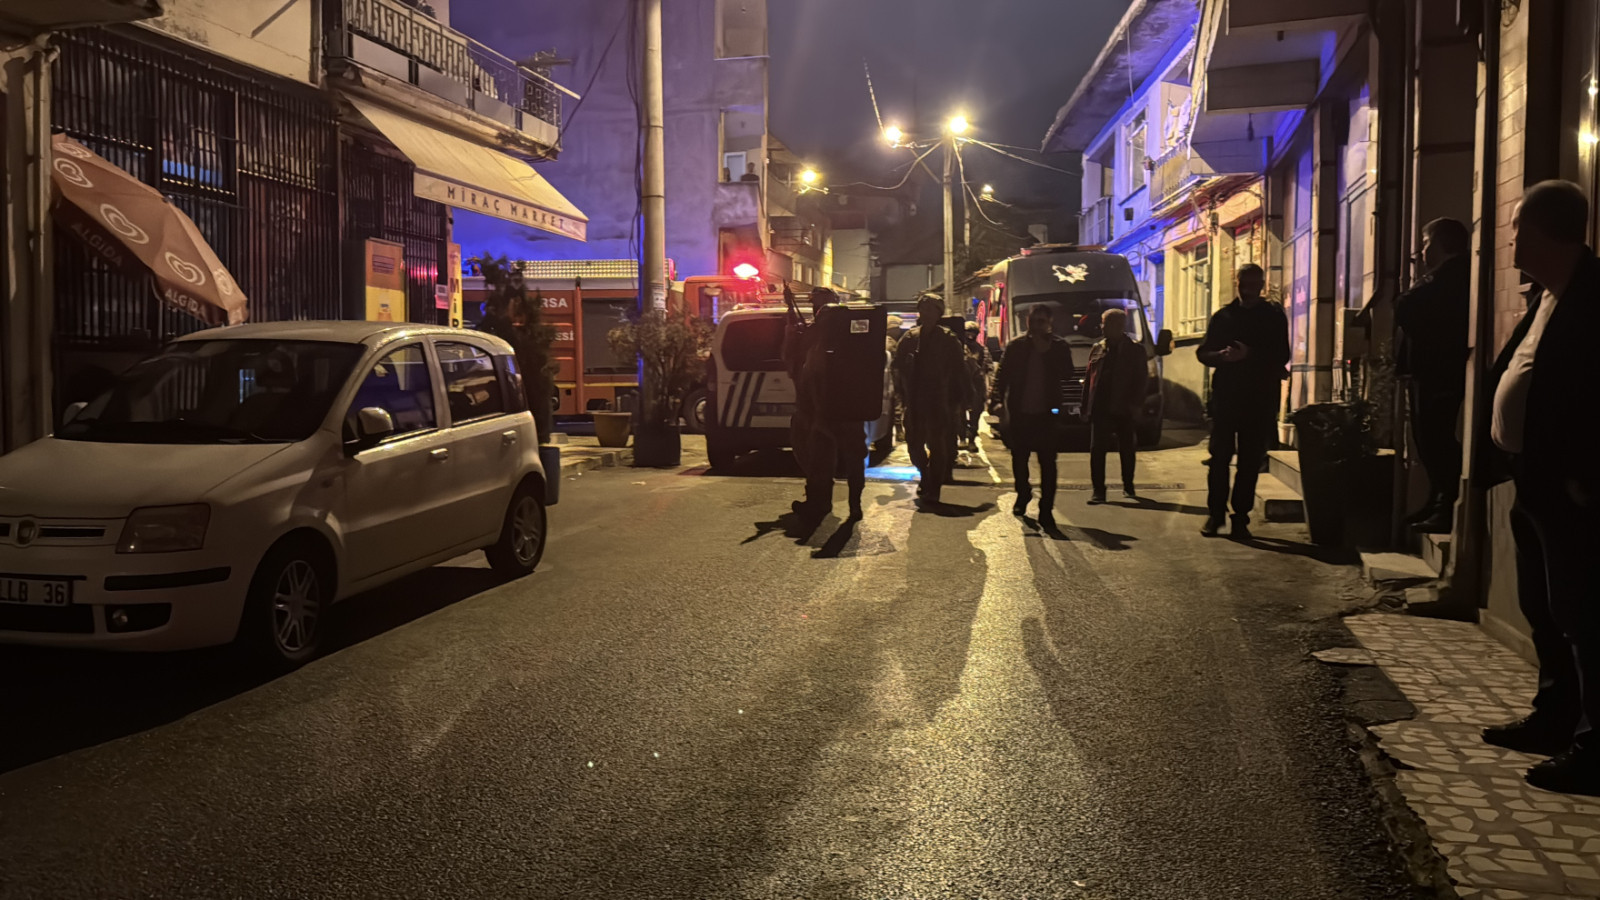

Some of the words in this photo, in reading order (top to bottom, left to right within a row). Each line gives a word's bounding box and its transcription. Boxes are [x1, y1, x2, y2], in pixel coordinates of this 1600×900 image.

[447, 185, 500, 214] MİRAÇ
[510, 203, 564, 229] MARKET
[71, 222, 123, 267] ALGIDA
[164, 288, 208, 320] ALGIDA
[541, 297, 568, 309] RSA
[43, 583, 65, 604] 36
